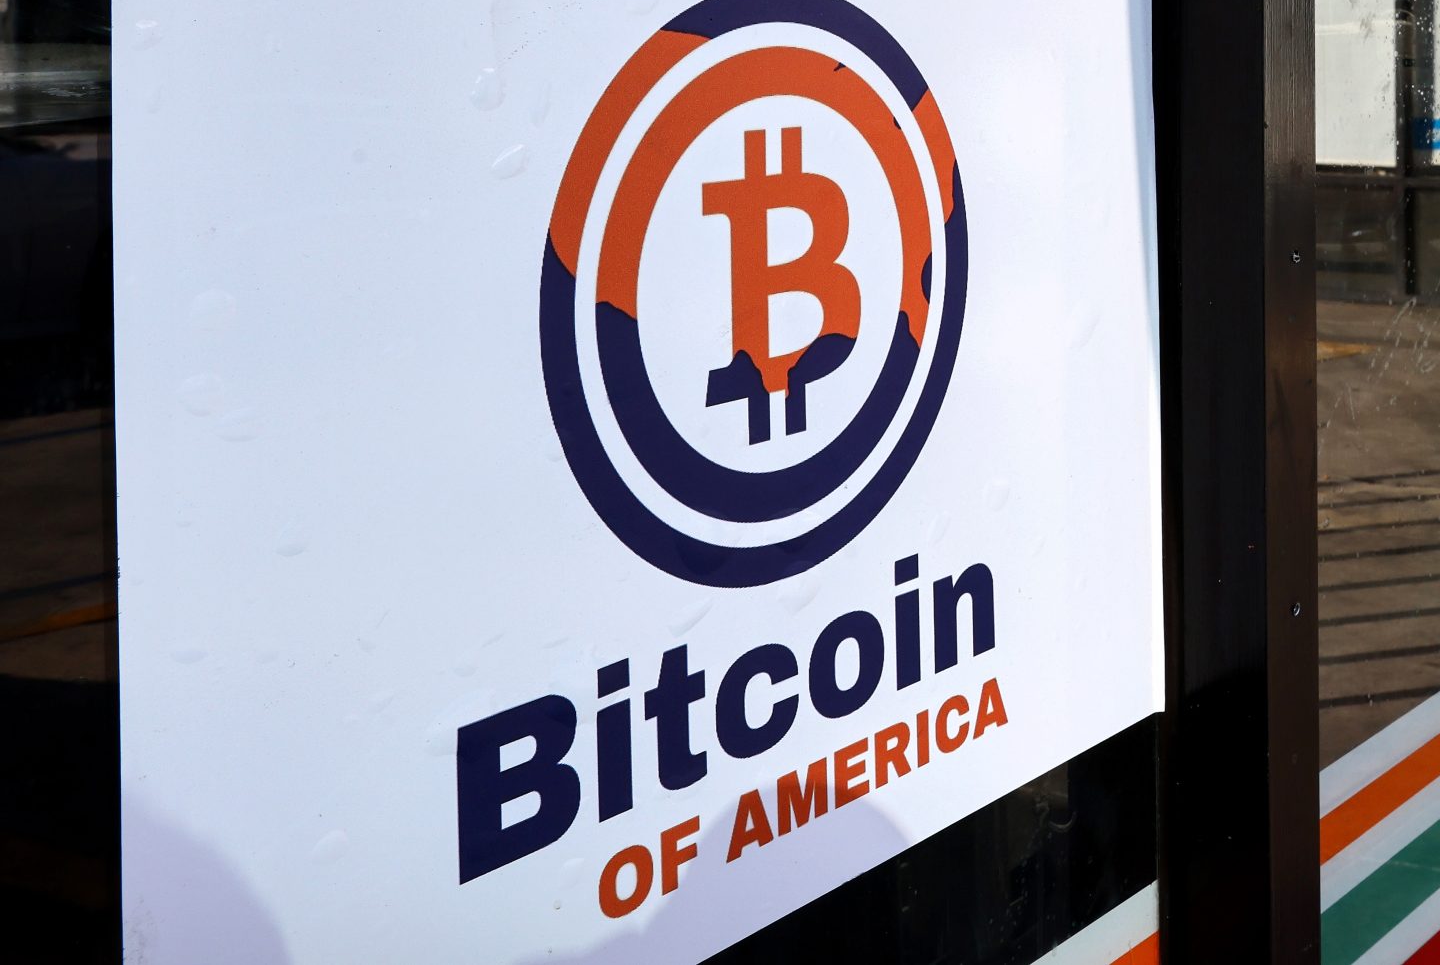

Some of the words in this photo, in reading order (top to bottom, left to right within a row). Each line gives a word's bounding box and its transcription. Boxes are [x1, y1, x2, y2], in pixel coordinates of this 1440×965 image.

[457, 554, 995, 885] Bitcoin
[599, 816, 699, 918] OF
[726, 679, 1008, 863] AMERICA
